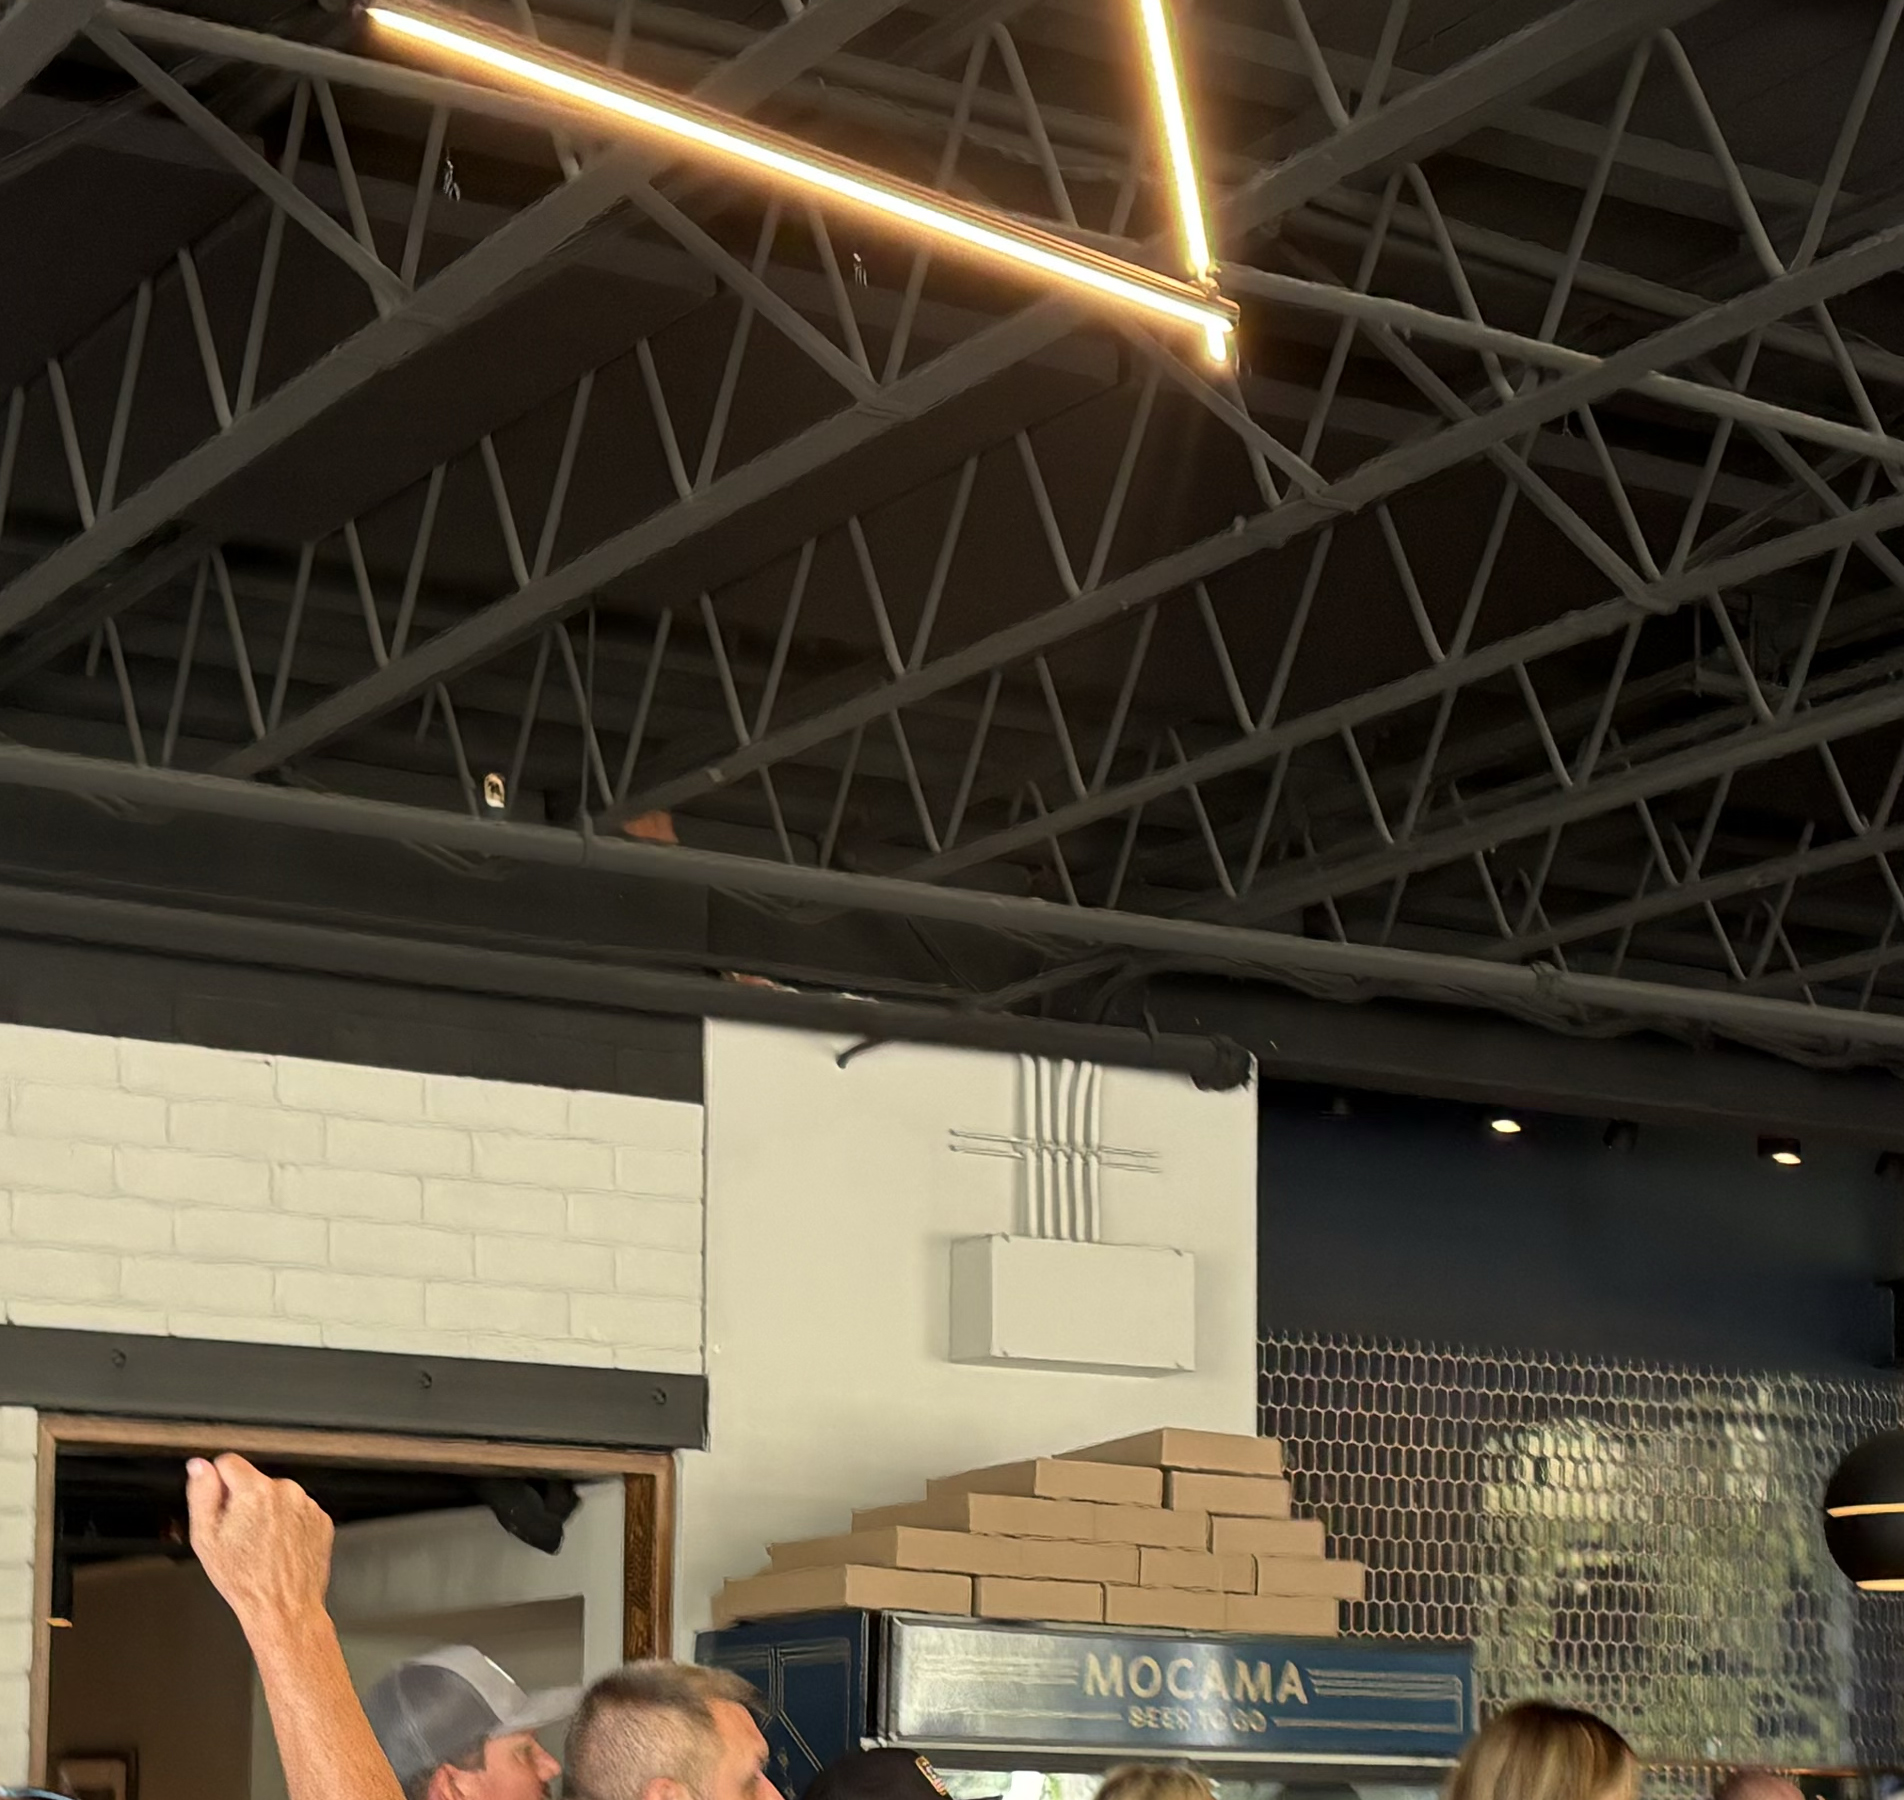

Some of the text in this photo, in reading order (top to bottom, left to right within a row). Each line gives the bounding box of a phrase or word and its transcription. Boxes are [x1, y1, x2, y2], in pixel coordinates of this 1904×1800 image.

[1082, 1652, 1309, 1705] MOCAMA
[1127, 1705, 1268, 1733] BEER TO GO
